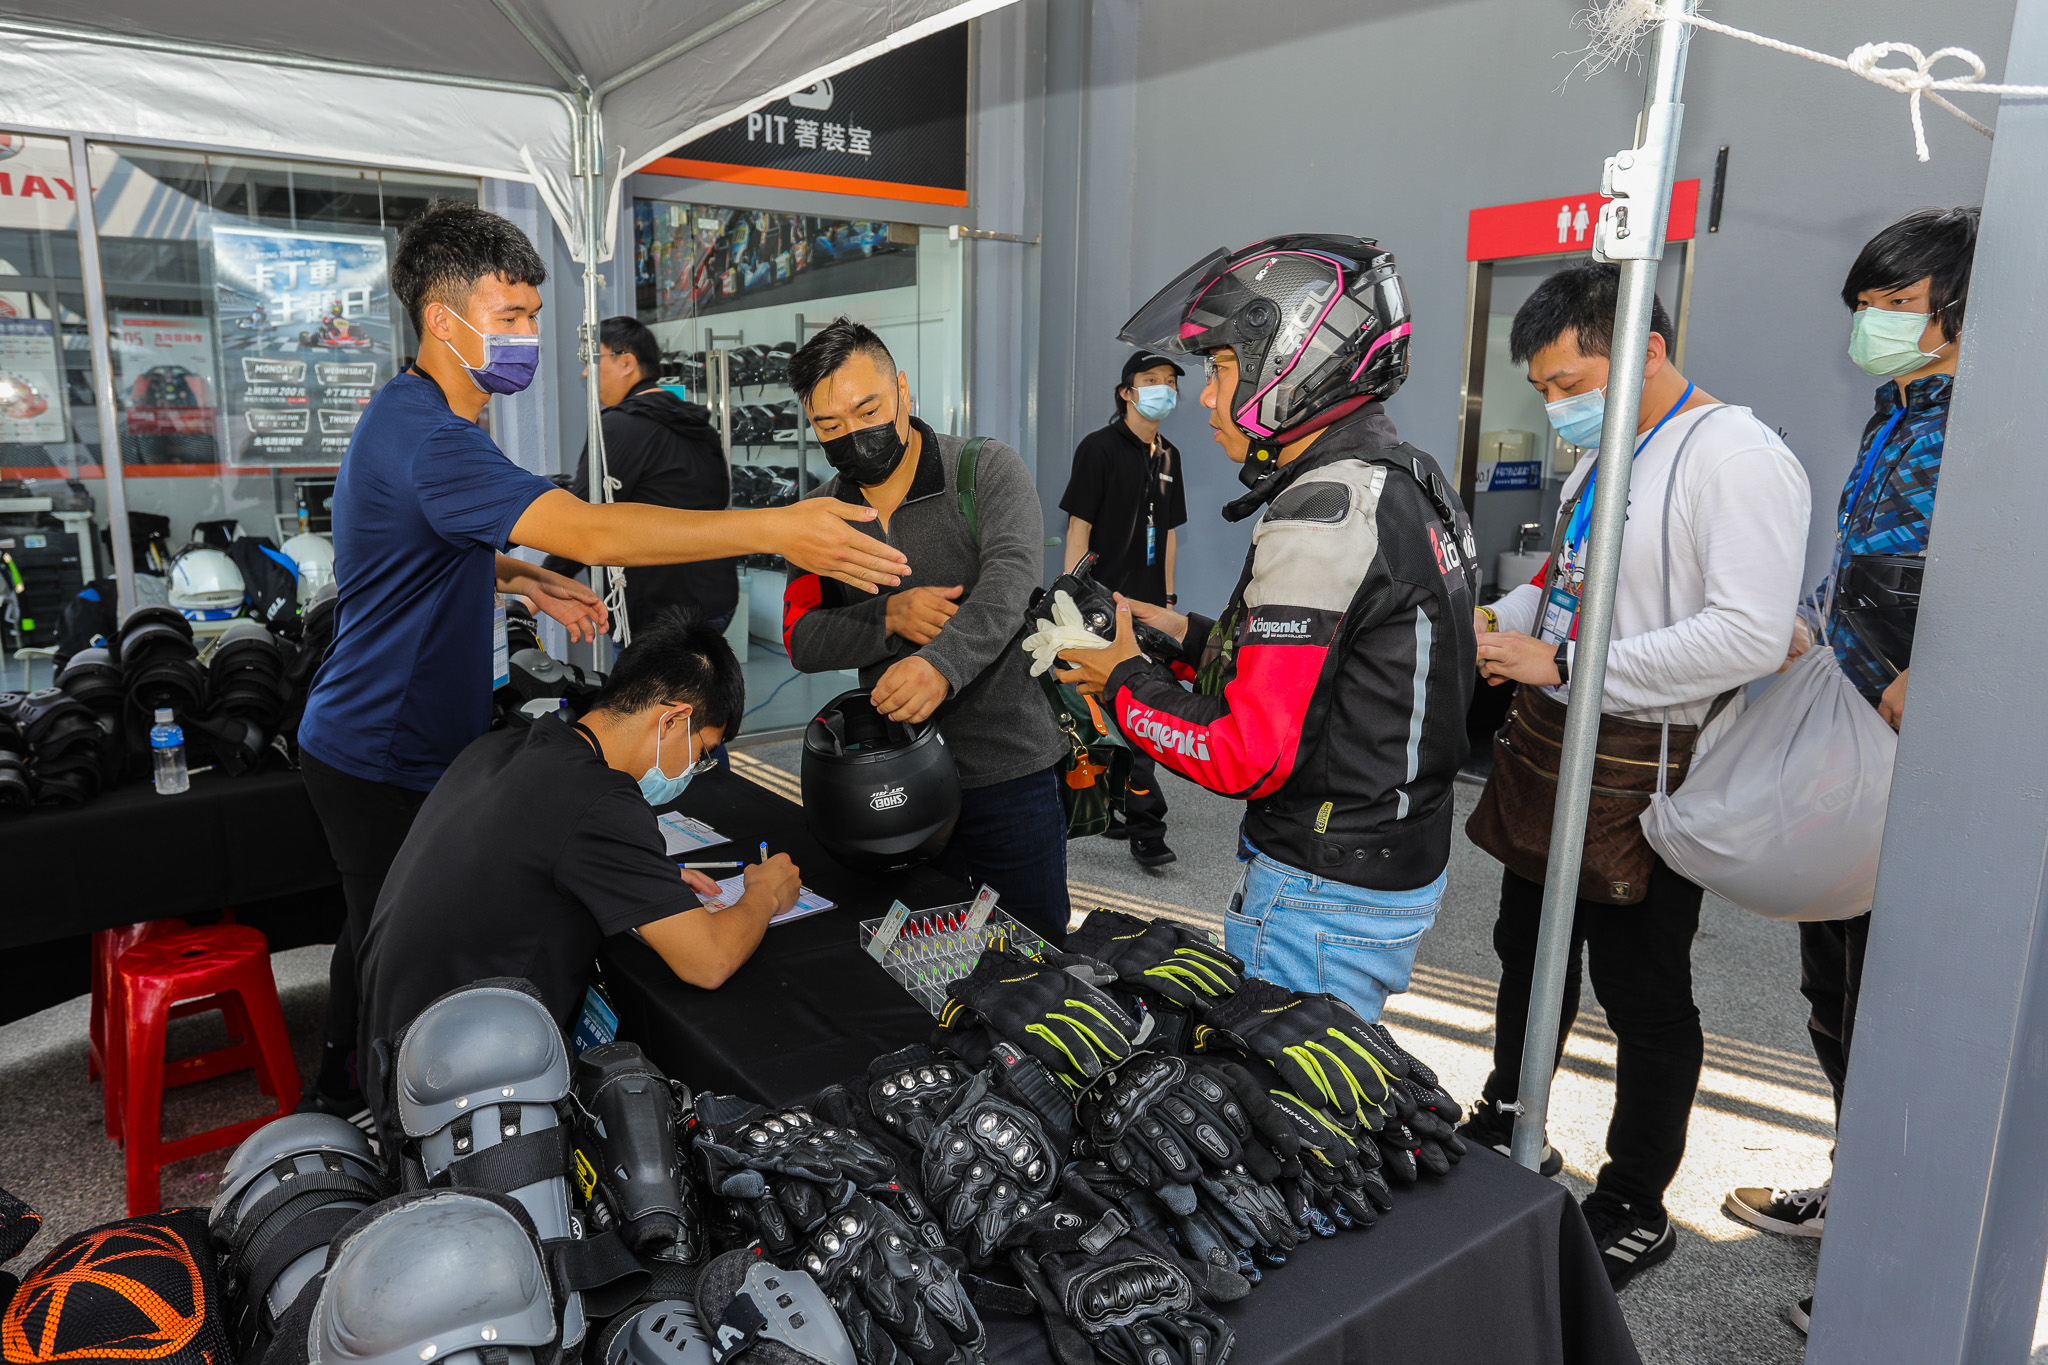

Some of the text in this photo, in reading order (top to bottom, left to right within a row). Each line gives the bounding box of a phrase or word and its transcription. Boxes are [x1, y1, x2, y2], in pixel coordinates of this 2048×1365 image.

[747, 112, 872, 156] PIT 著裝室
[247, 258, 338, 293] 卡丁車
[270, 285, 373, 327] 主題日
[254, 364, 295, 374] MONDAY
[323, 367, 368, 375] WEDNESDAY
[1249, 617, 1308, 639] Kögenki
[1127, 704, 1211, 761] Kögenki
[875, 794, 903, 809] SHOEI
[1351, 1026, 1400, 1066] KOMINE
